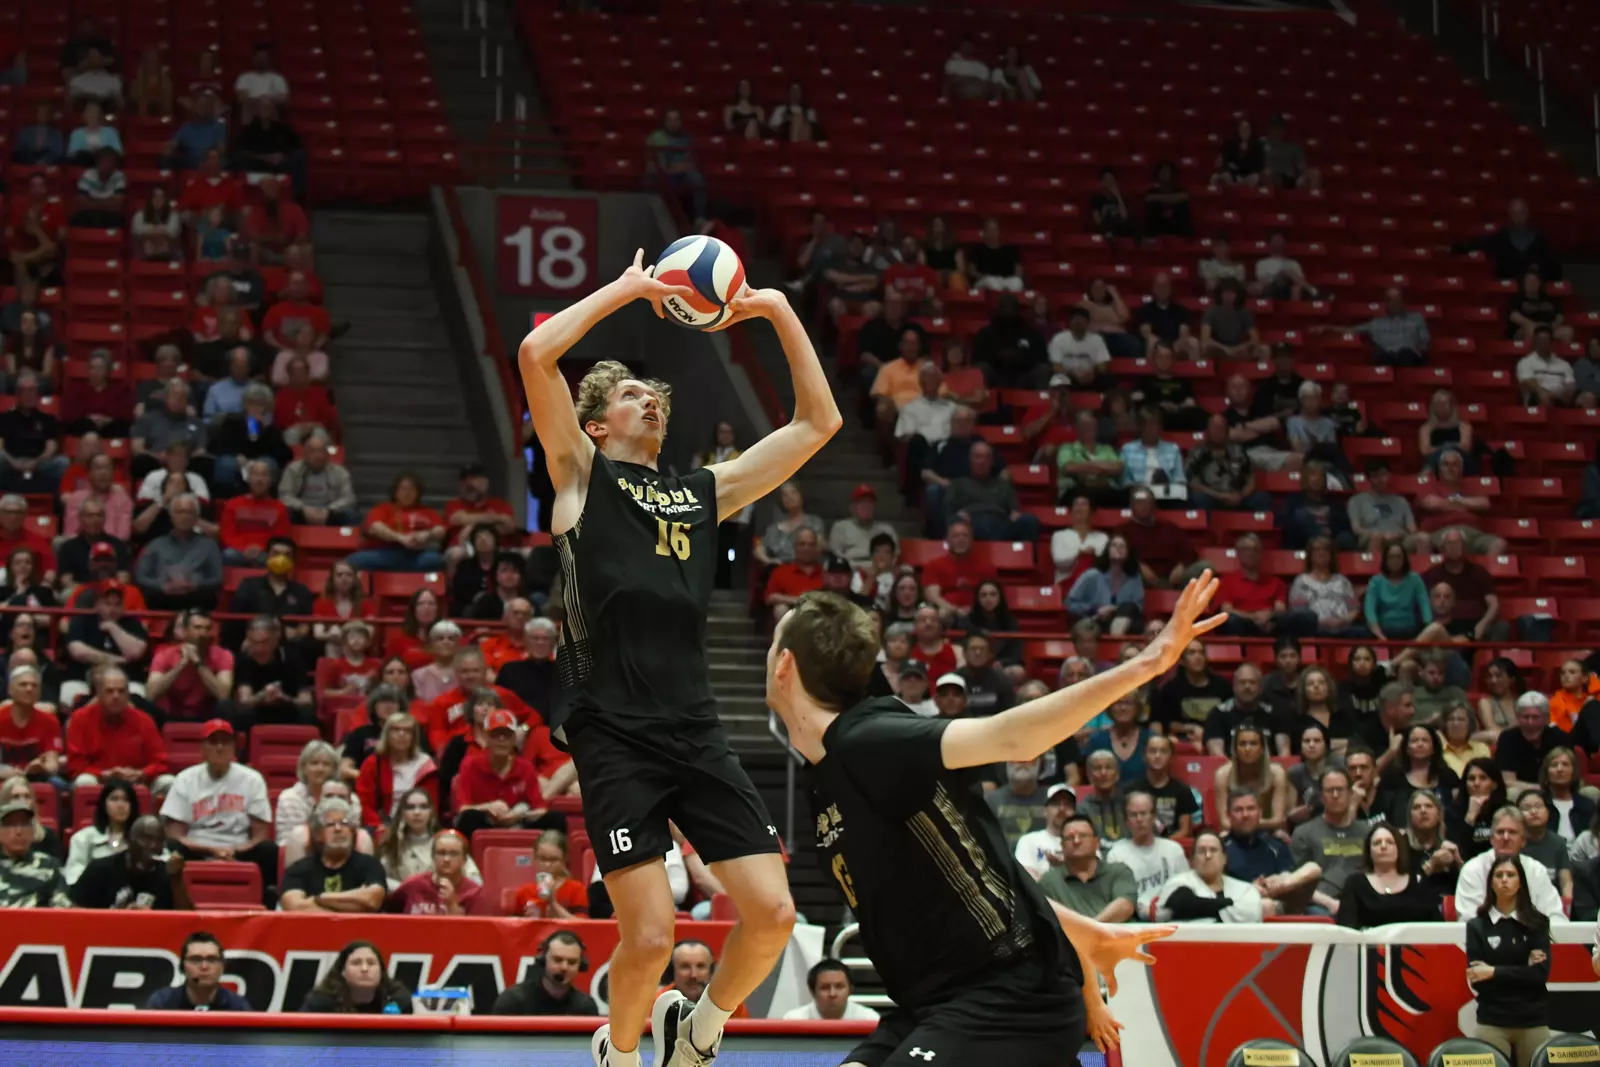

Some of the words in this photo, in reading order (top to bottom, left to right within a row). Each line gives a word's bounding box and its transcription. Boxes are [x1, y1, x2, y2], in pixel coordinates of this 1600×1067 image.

[504, 225, 587, 289] 18
[668, 297, 697, 323] NCAA
[654, 515, 691, 561] 16
[609, 828, 633, 855] 16
[1557, 1050, 1598, 1059] GAINBRIDGE
